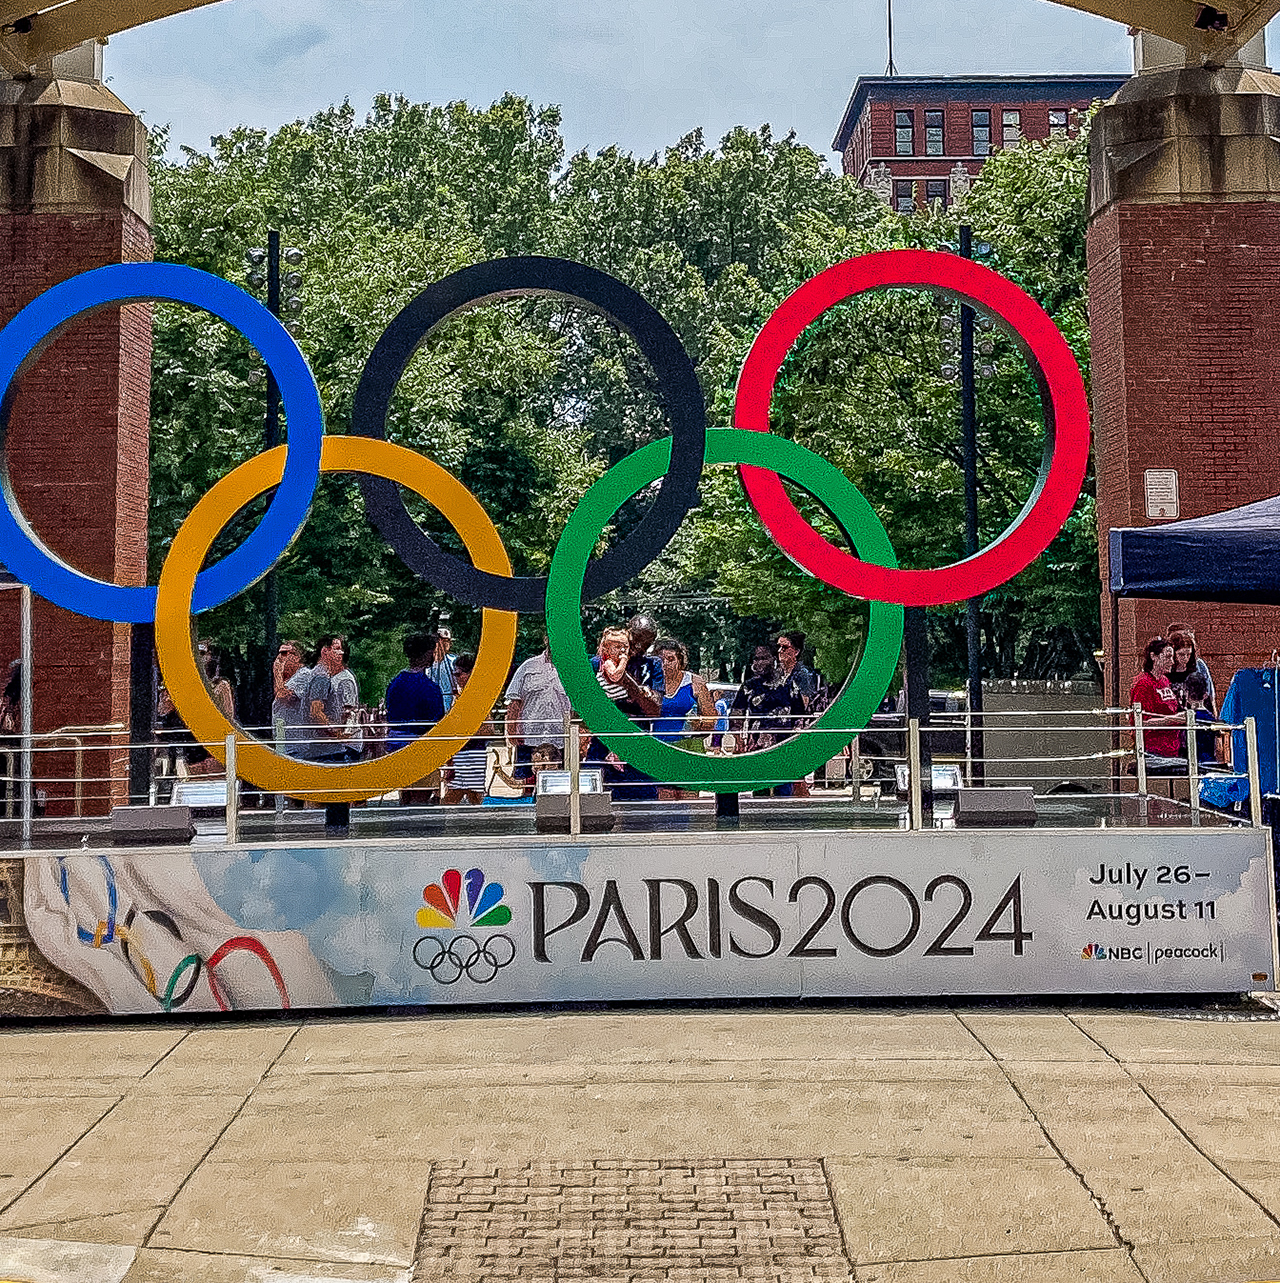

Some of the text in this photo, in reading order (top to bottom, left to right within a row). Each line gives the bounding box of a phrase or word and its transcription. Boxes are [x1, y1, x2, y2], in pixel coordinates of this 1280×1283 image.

[1089, 862, 1148, 891] July
[1086, 899, 1216, 927] August 11
[1108, 942, 1218, 965] NBC peacock
